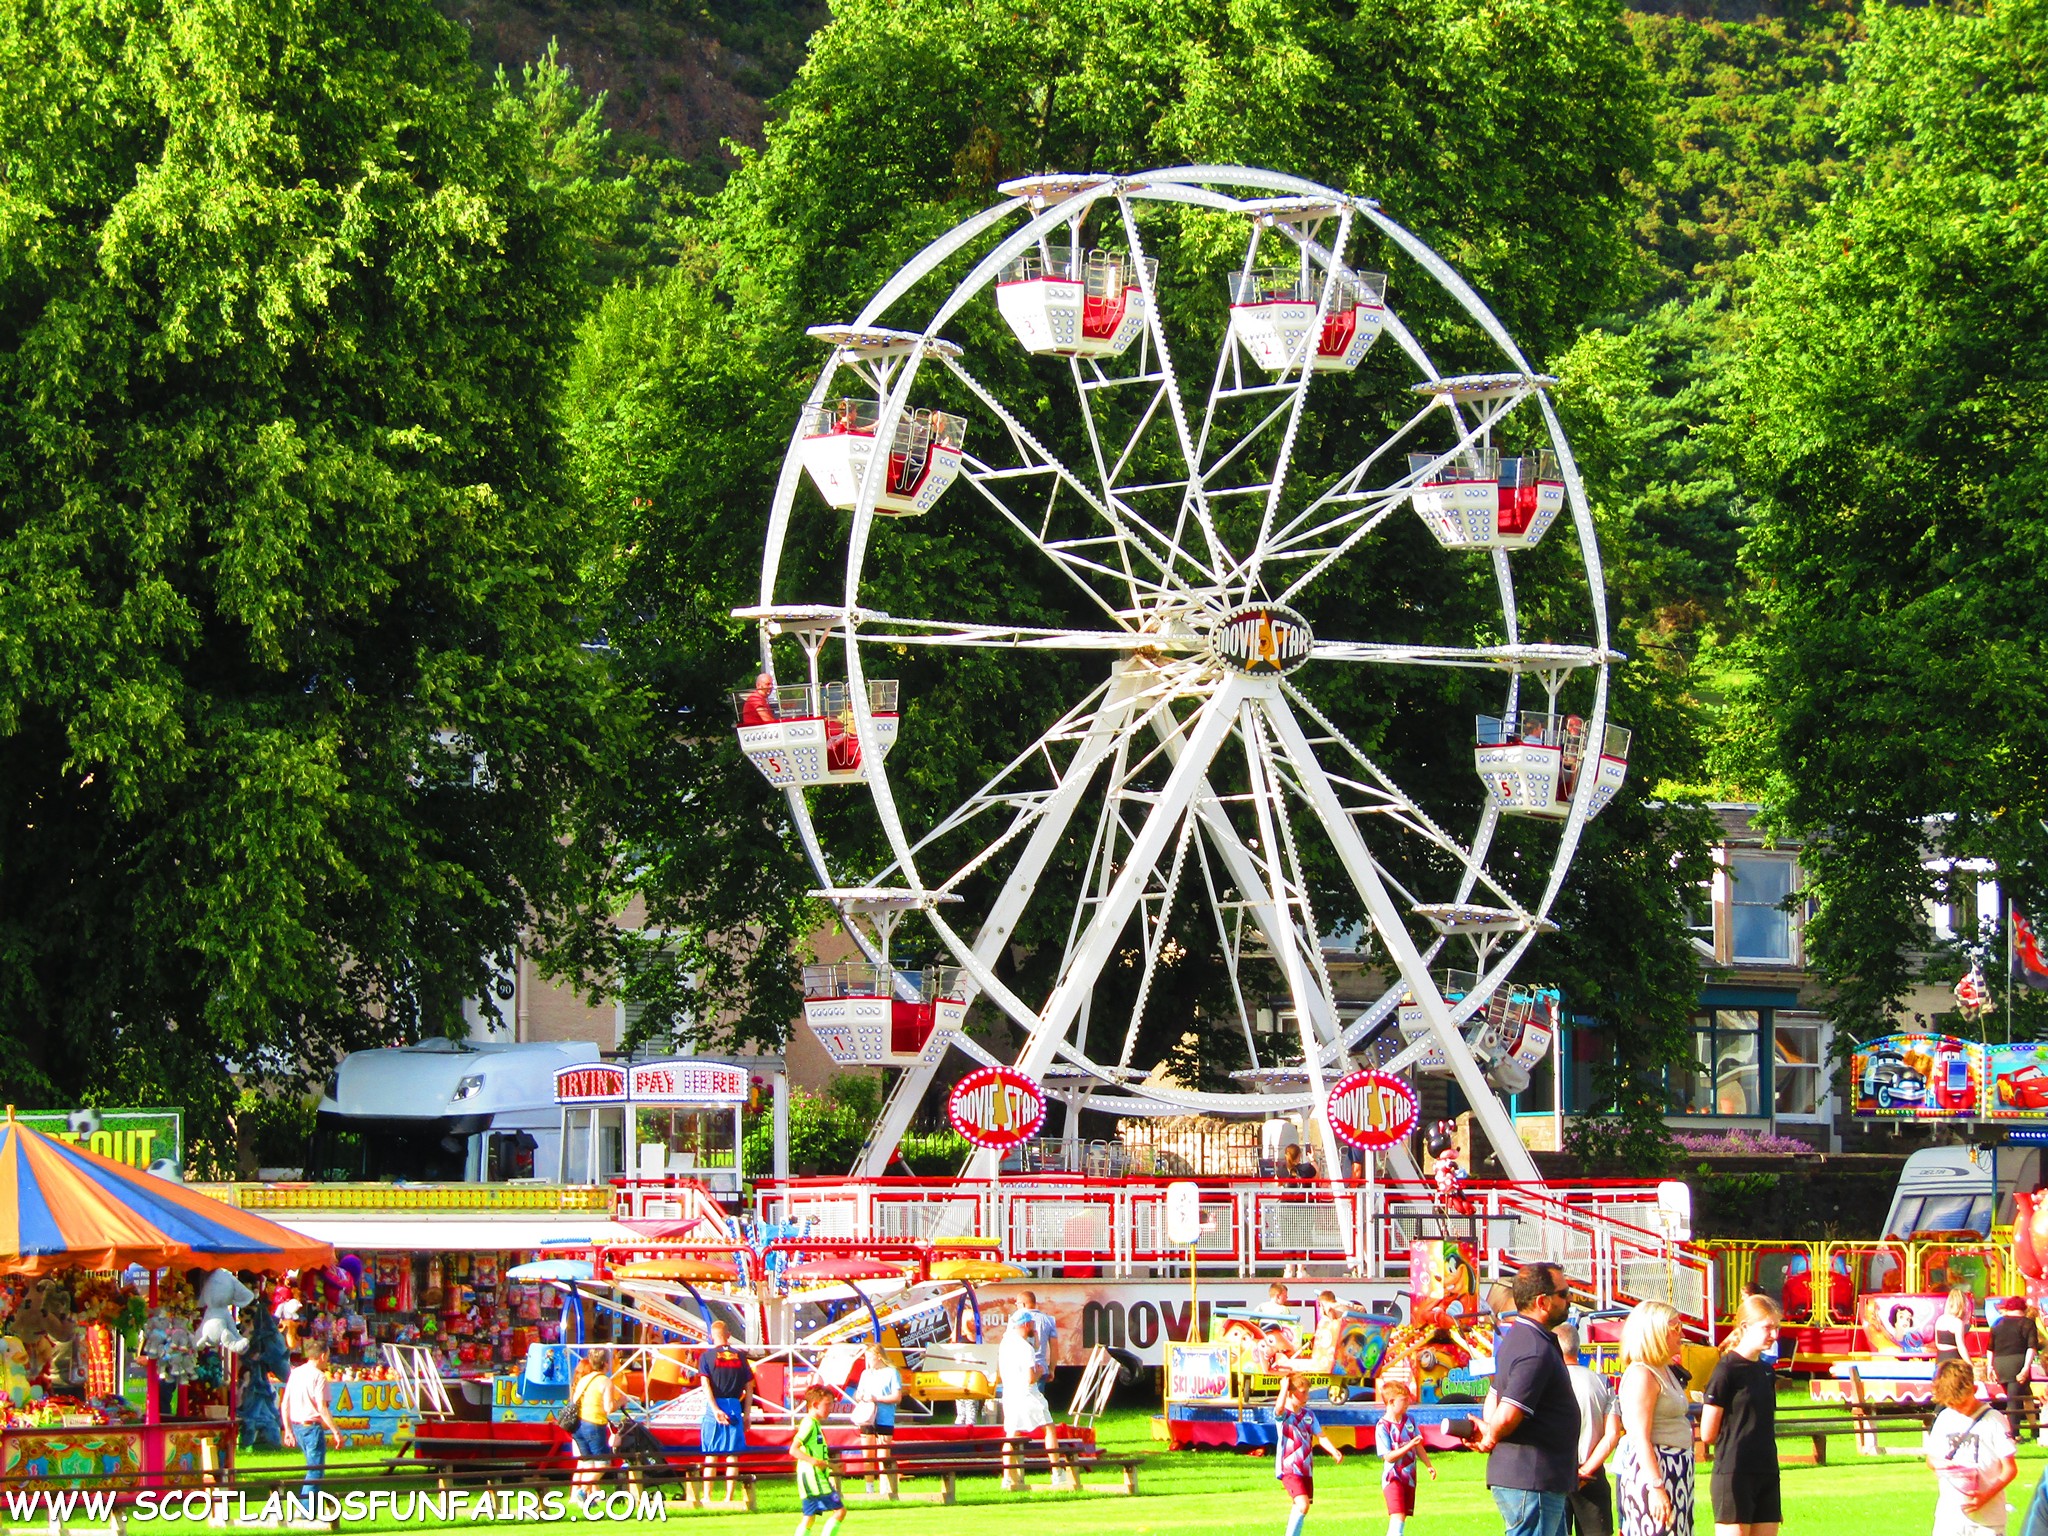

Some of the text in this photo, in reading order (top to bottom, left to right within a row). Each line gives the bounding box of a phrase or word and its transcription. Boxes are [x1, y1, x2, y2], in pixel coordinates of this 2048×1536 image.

[1024, 319, 1036, 336] 3
[1260, 340, 1272, 355] 2
[829, 472, 839, 488] 4
[1216, 618, 1315, 662] MOVIE STAR
[768, 757, 782, 773] 5
[1500, 781, 1512, 797] 5
[499, 984, 512, 994] 90
[561, 1070, 623, 1097] IRVIN'S
[636, 1070, 742, 1093] PAY HERE
[956, 1083, 1040, 1132] MOVIE STAR
[1332, 1085, 1412, 1132] MOVIE STAR
[1082, 1300, 1247, 1349] MOVI
[1173, 1375, 1226, 1395] SKI JUMP
[1316, 1377, 1330, 1385] OFF
[336, 1383, 354, 1412] A
